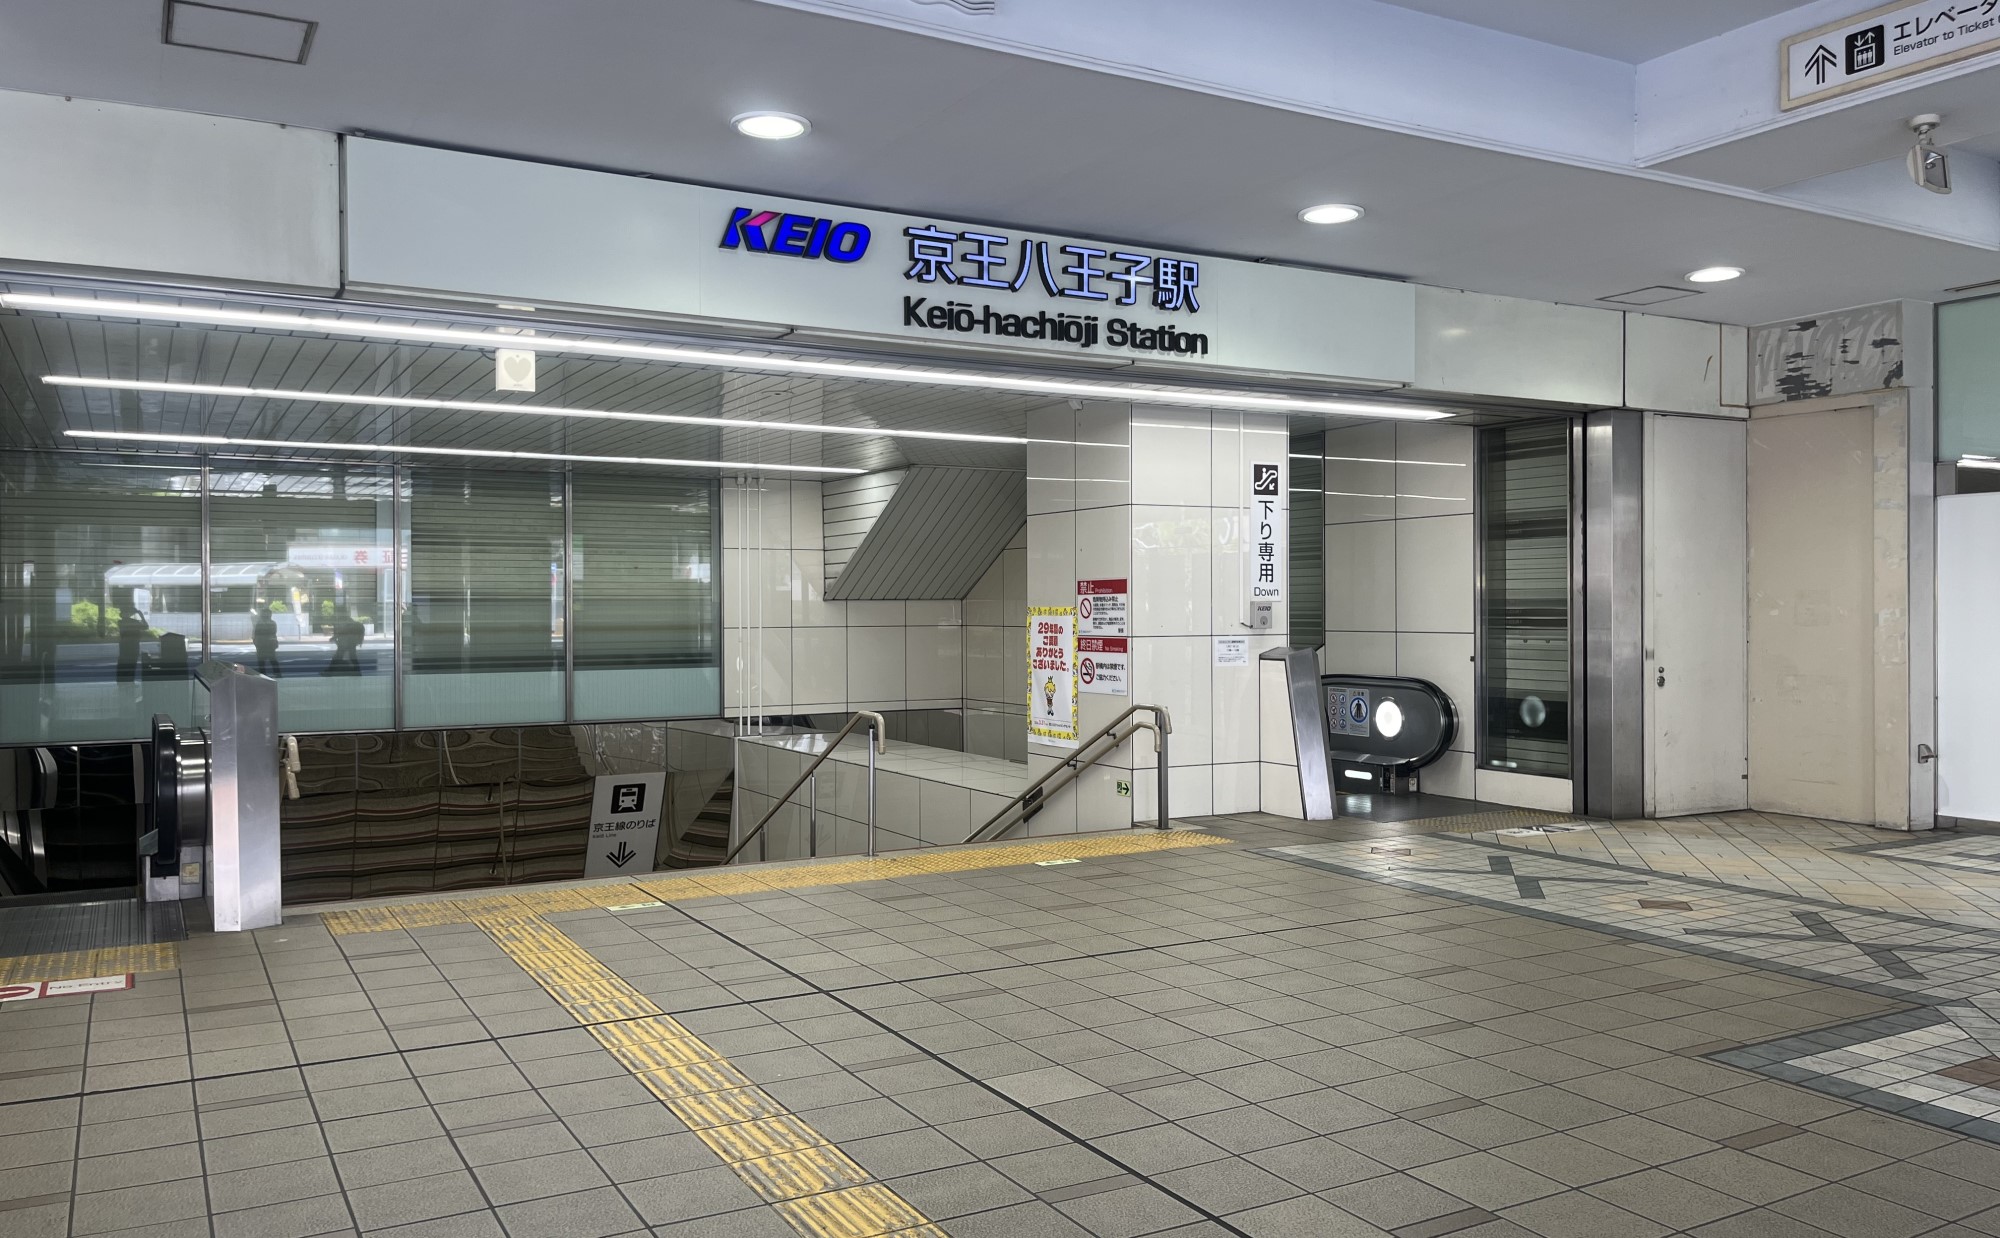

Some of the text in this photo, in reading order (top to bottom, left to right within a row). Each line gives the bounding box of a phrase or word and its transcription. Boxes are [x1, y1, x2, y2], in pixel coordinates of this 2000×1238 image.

[1893, 34, 1939, 56] Elevator
[1942, 29, 1955, 42] to
[1958, 17, 1996, 36] Ticket
[719, 207, 871, 263] KEIO
[903, 225, 1200, 313] 京王八王子駅
[903, 296, 1208, 356] Keiō-hachiōji Station
[1258, 500, 1275, 583] 下り専用
[1080, 581, 1095, 594] 禁止
[1253, 586, 1279, 597] Down
[1035, 647, 1064, 660] ありがとう
[1032, 659, 1070, 673] ございました。
[593, 819, 656, 833] 京王線のりば
[78, 980, 123, 988] Entry
